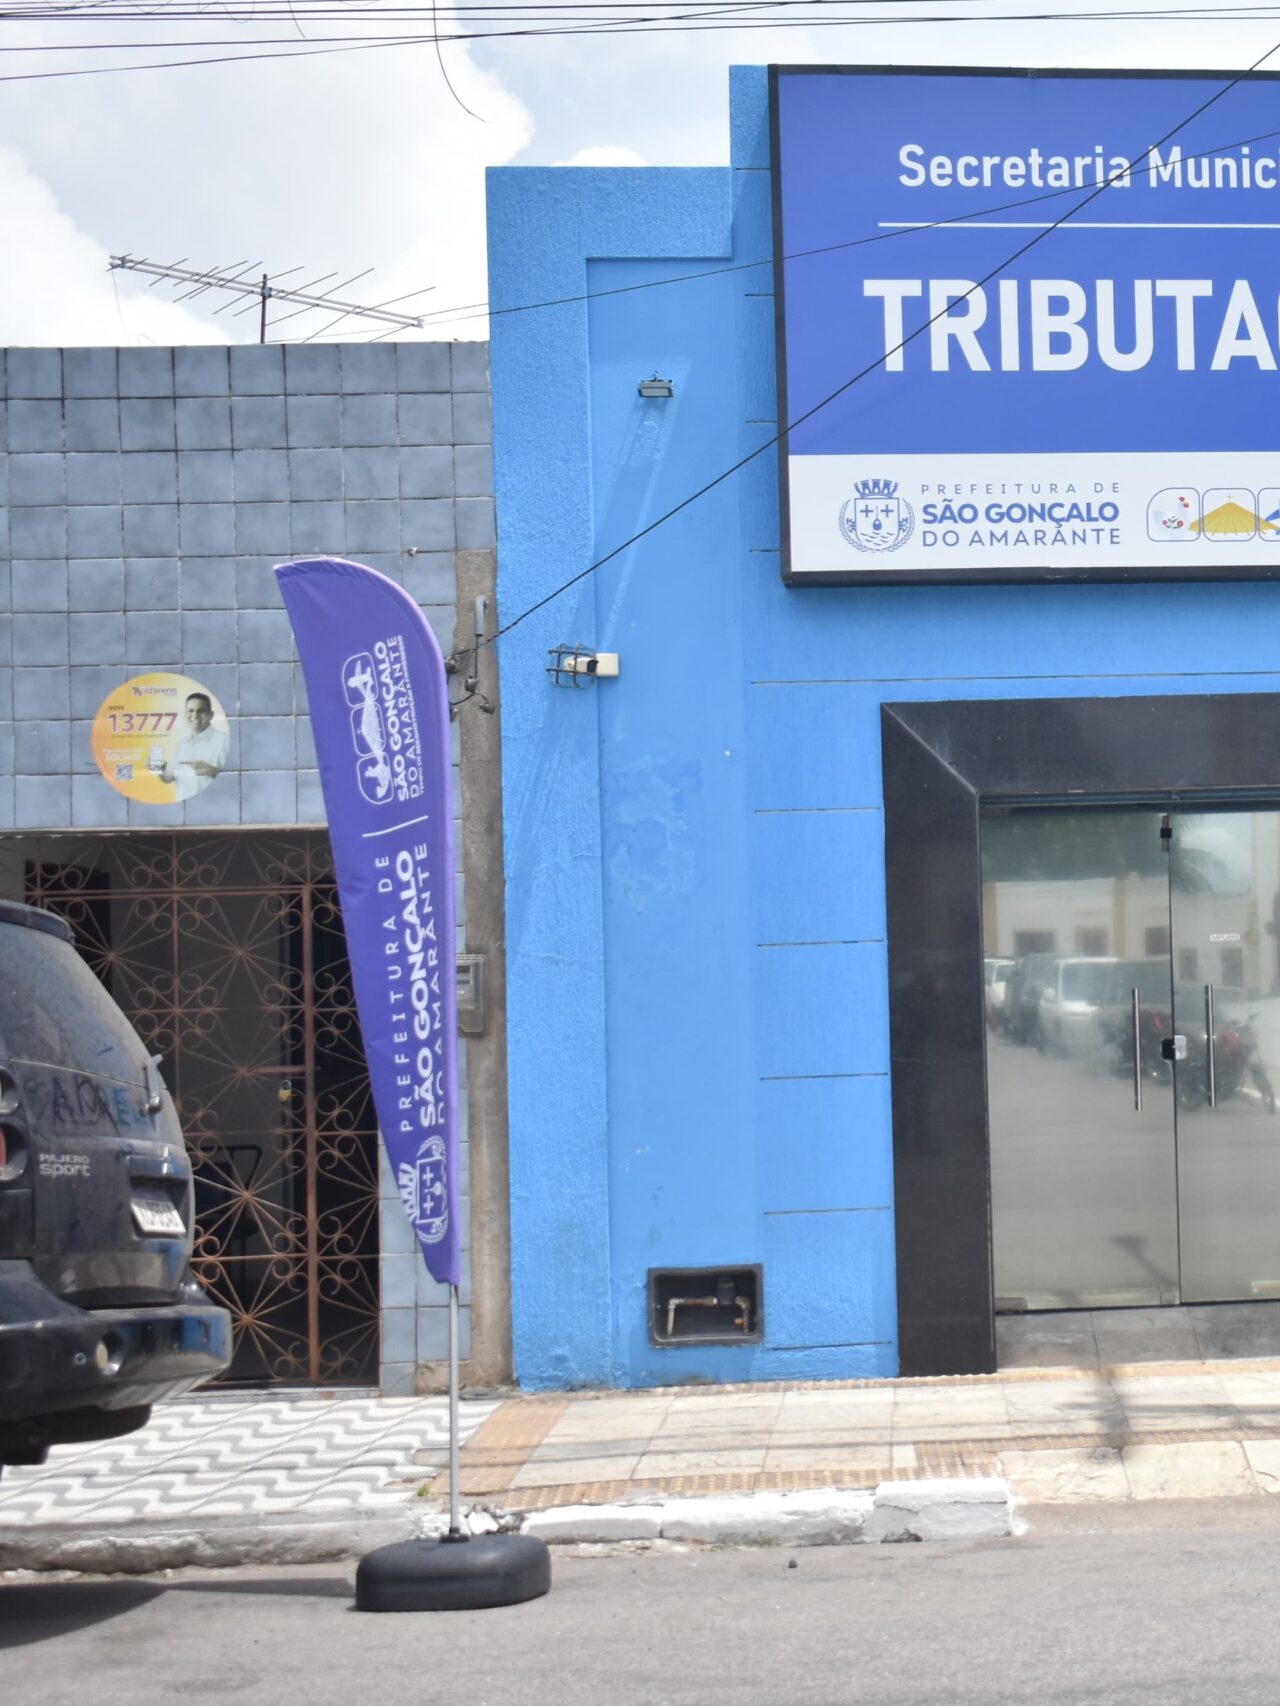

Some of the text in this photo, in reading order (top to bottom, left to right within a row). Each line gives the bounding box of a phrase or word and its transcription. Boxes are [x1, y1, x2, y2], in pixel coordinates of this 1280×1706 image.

[898, 143, 1132, 189] Secretaria
[921, 482, 1120, 495] PREFEITURA DE
[922, 498, 1120, 528] SÃO GONÇALO
[922, 528, 1121, 547] DO AMARANTE
[108, 712, 178, 732] 13777
[374, 641, 409, 802] SÃO GONÇALO
[387, 635, 420, 799] DO AMARANTE
[414, 843, 443, 1056] AMARANTE
[375, 856, 413, 1132] PREFEITURA DE
[396, 850, 436, 1128] SÃO GONÇALO
[39, 1153, 90, 1164] PAJERO
